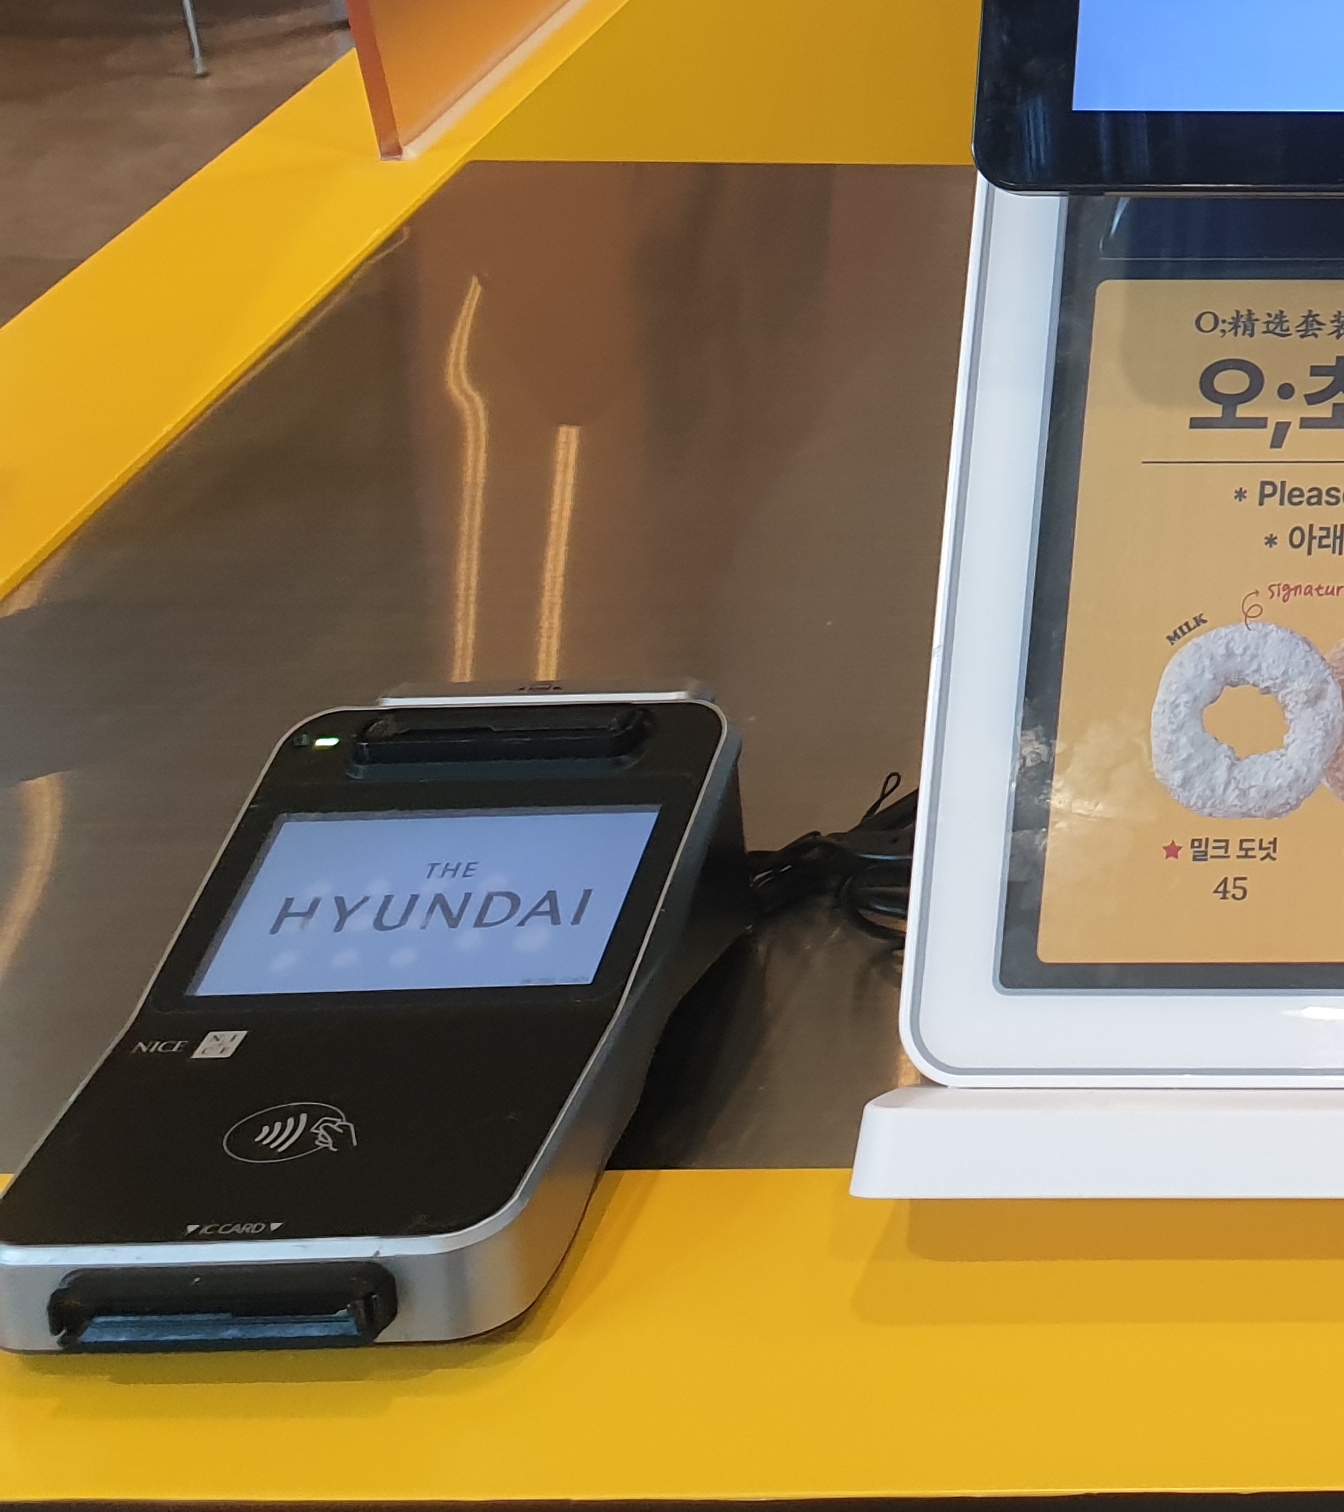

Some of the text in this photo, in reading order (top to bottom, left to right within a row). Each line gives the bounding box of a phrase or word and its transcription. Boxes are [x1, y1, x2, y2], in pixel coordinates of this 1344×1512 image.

[1288, 522, 1344, 557] 아래
[1164, 612, 1209, 646] MILK
[1189, 836, 1279, 862] 밀크 도넛
[424, 860, 480, 881] THE
[1212, 875, 1249, 901] 45
[269, 888, 594, 936] HYUNDAI
[130, 1040, 190, 1054] NICE
[217, 1222, 267, 1235] CARD
